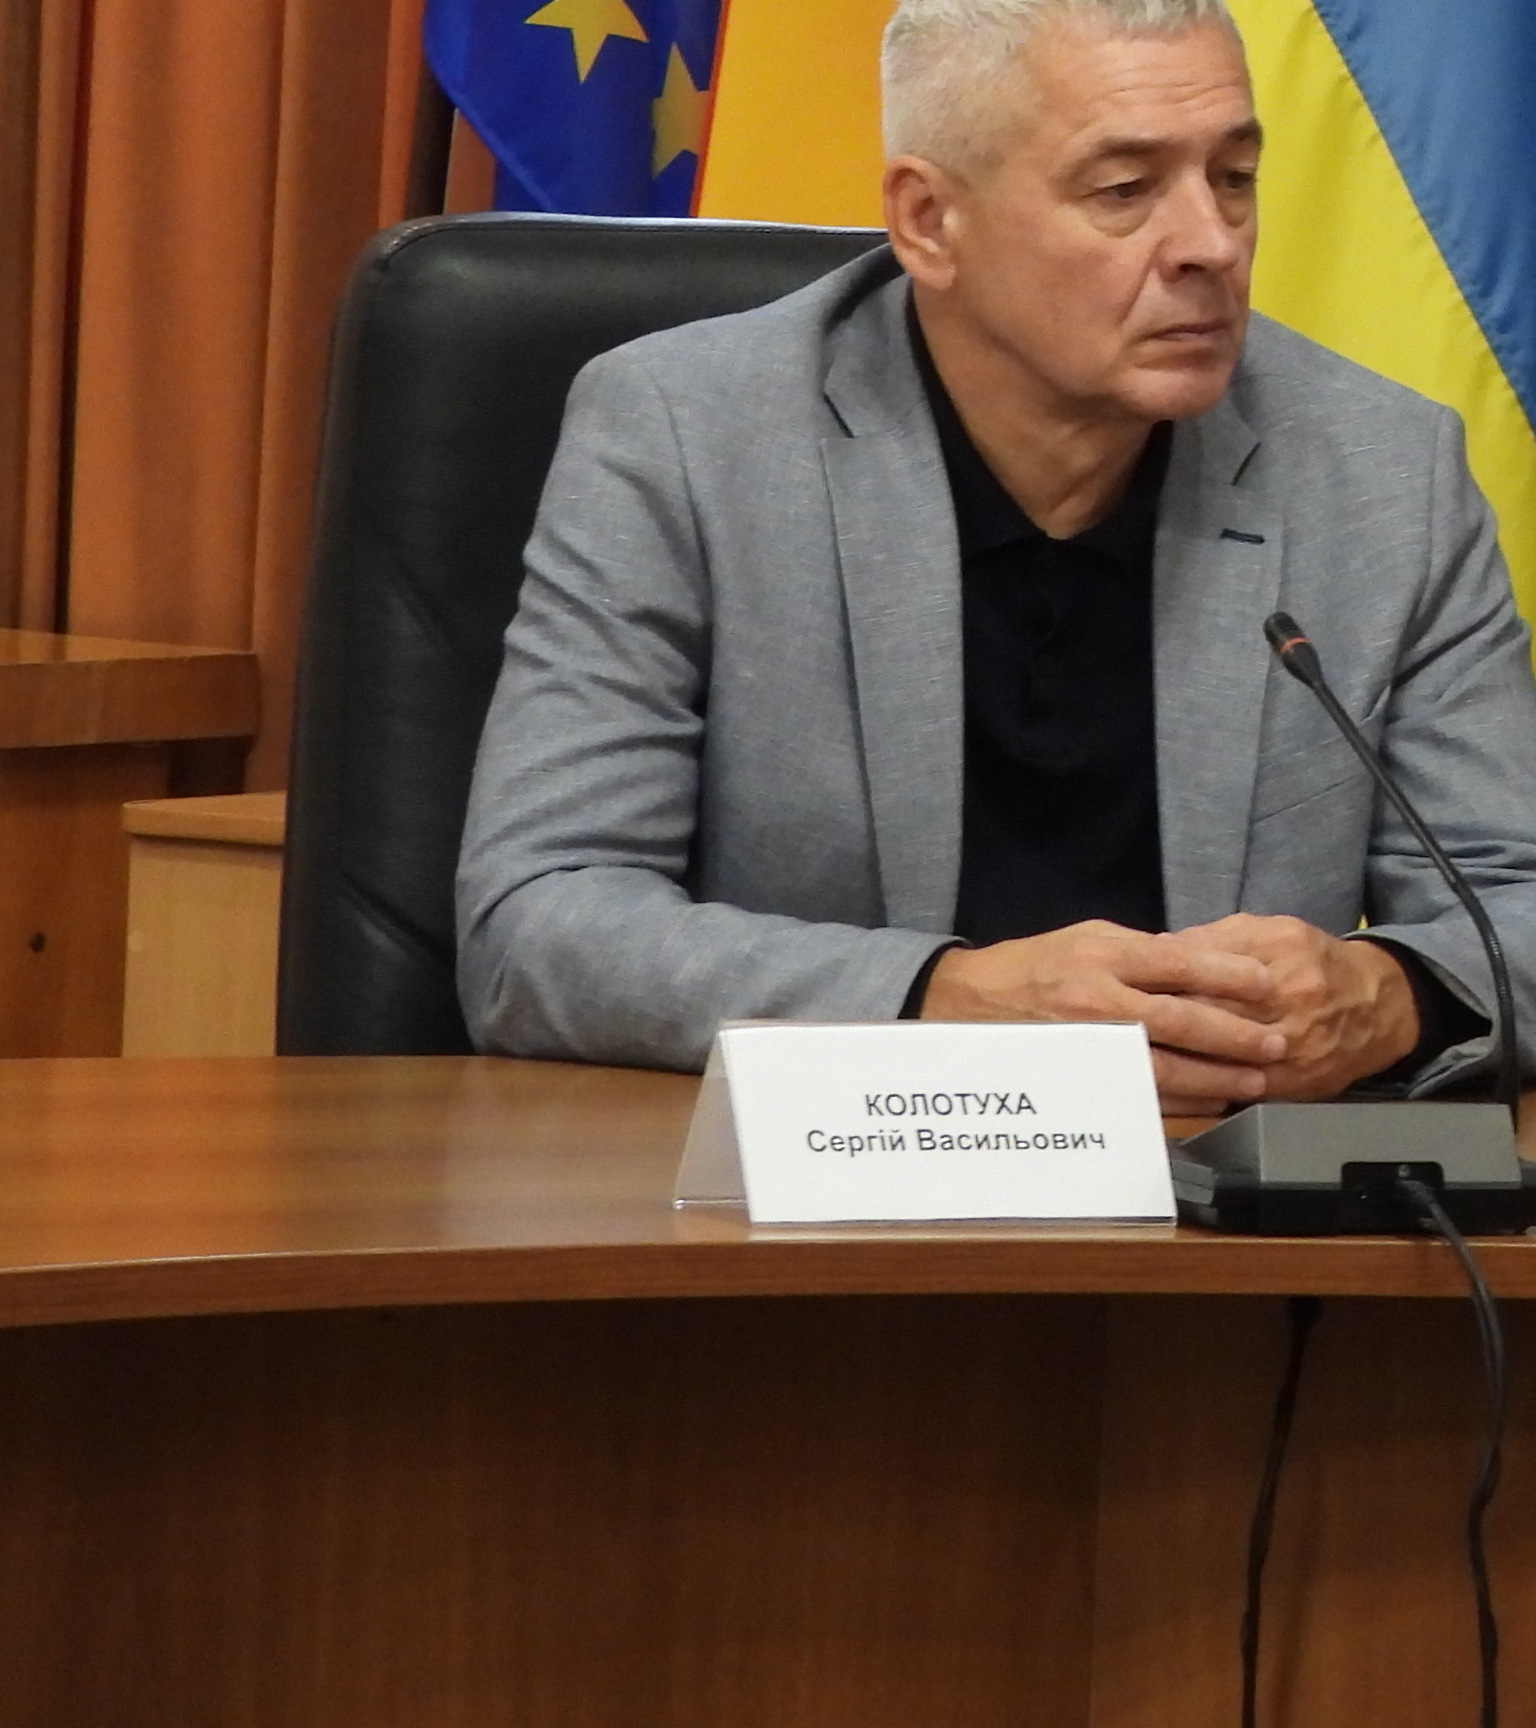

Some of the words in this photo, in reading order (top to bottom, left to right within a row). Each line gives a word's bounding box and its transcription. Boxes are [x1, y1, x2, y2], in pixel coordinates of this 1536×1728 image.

[865, 1093, 1037, 1116] КОЛОТУХА
[806, 1127, 906, 1155] Сергій
[916, 1129, 1105, 1151] Васильович
